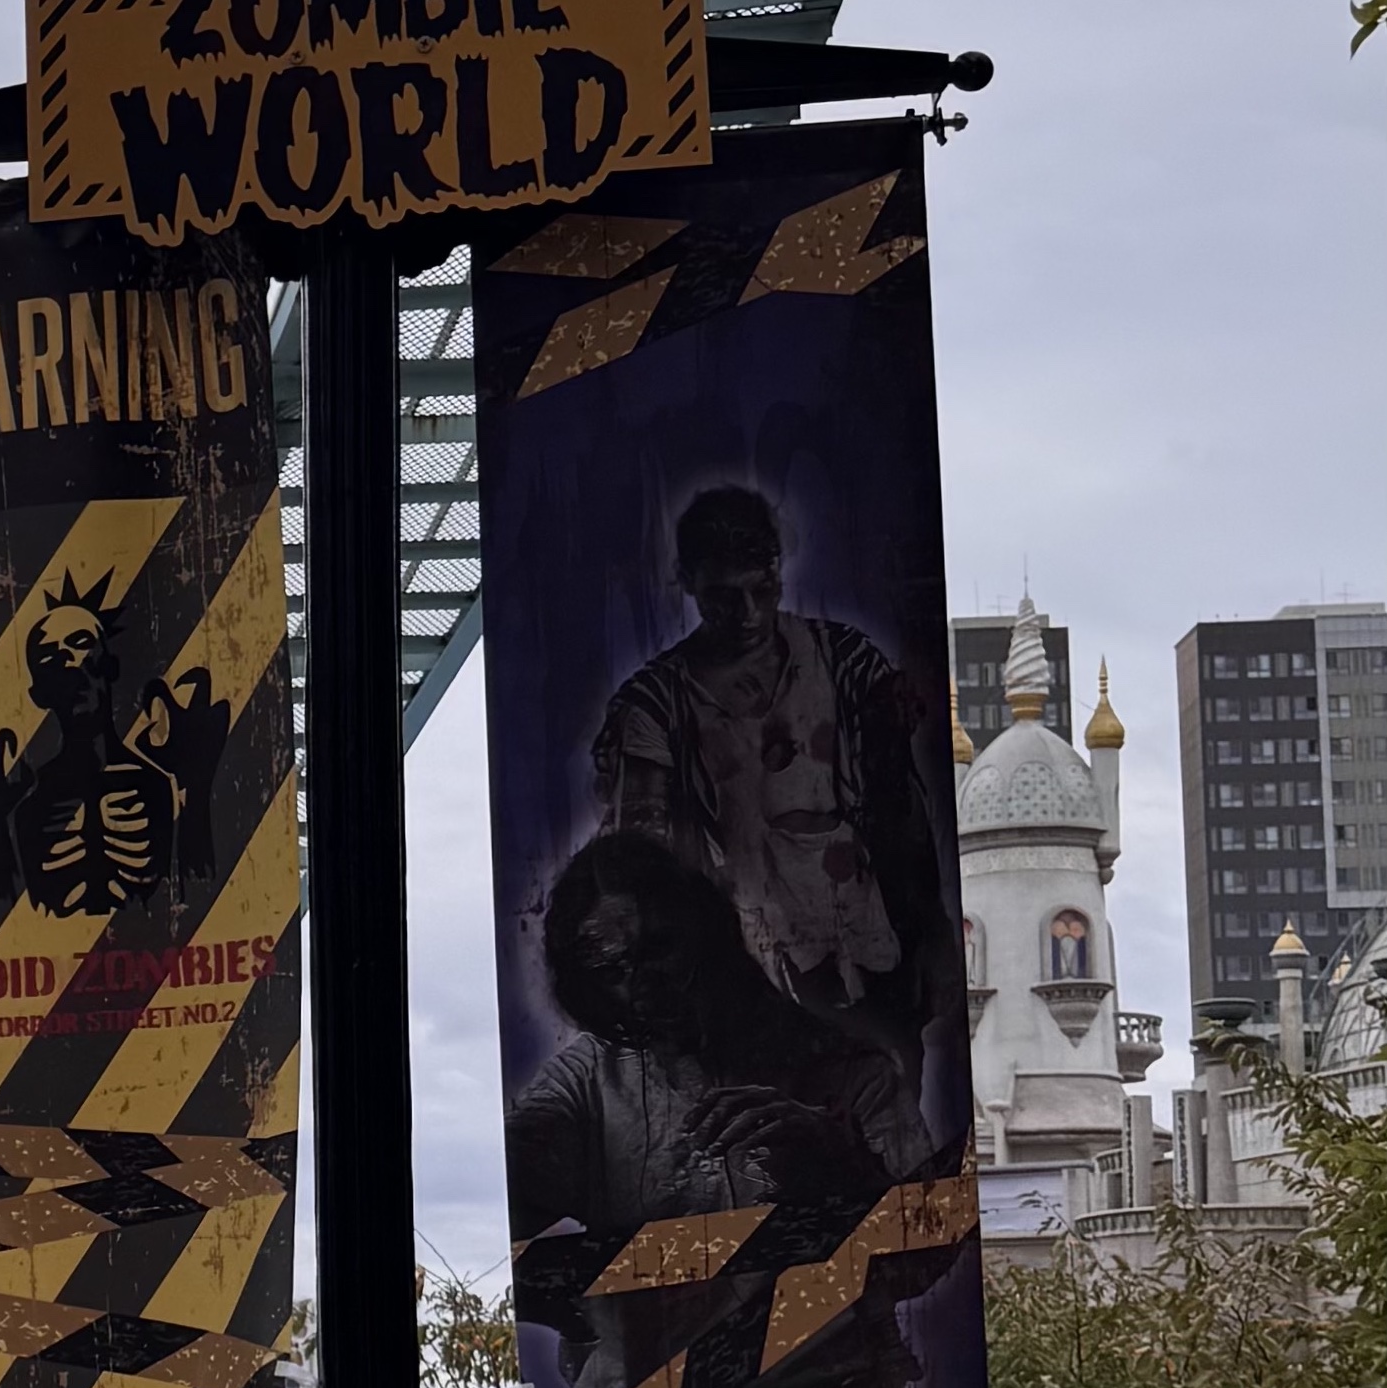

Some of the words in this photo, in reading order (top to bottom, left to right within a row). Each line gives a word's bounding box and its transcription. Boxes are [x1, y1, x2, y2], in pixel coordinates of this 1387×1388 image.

[110, 48, 628, 224] WORLD
[73, 935, 277, 996] ZOMBIES
[86, 1006, 176, 1032] STREET
